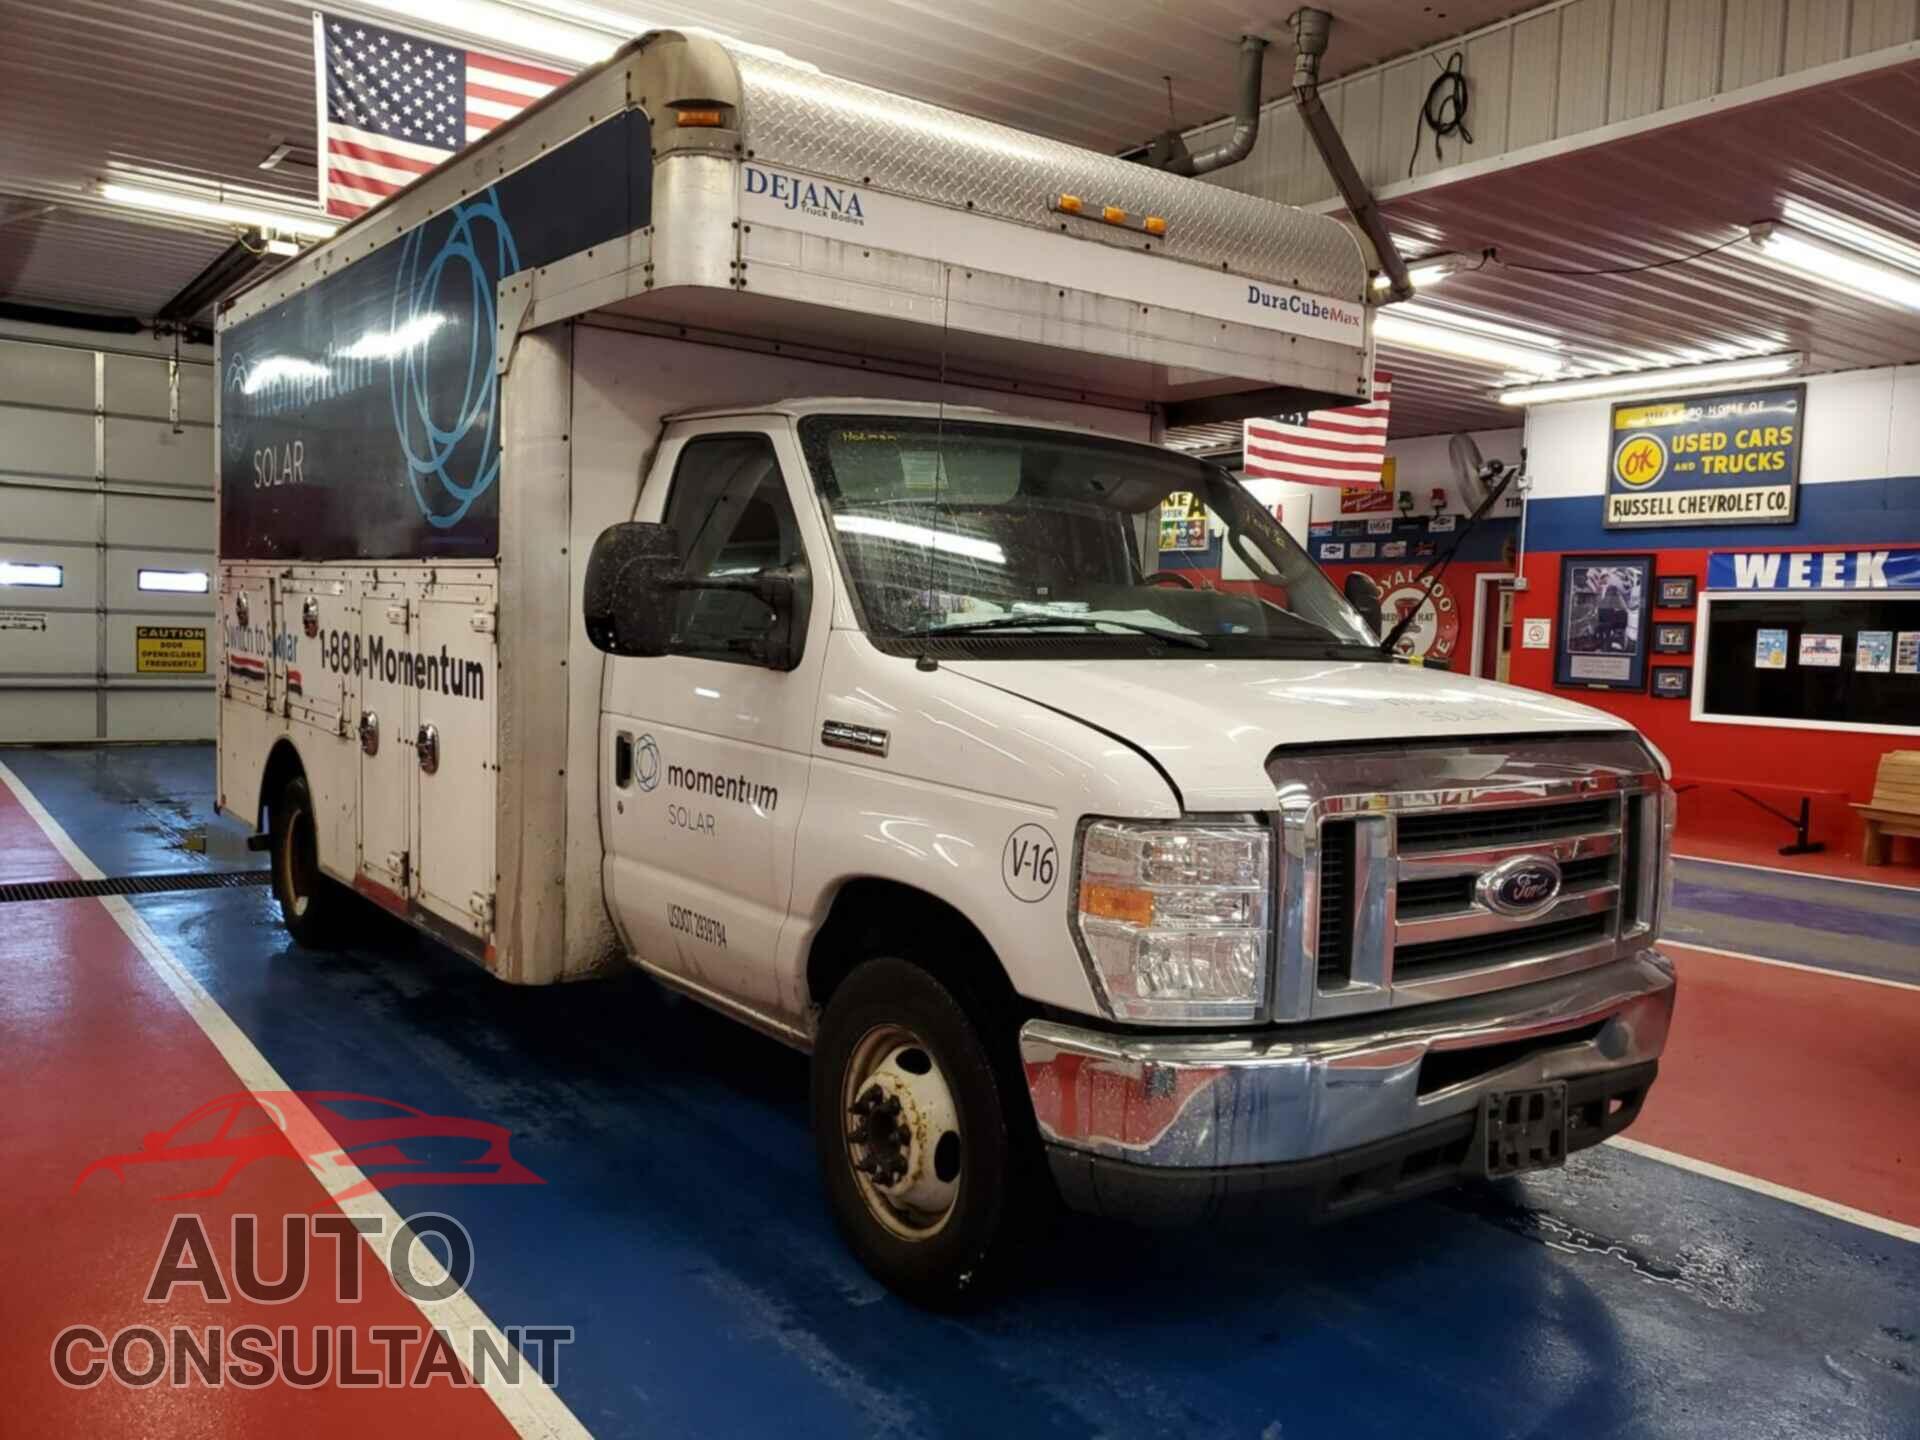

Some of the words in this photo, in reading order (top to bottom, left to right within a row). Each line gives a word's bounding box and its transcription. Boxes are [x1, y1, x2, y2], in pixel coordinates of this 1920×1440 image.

[745, 167, 864, 218] DEJANA
[801, 205, 829, 220] Truck
[831, 211, 865, 227] Bodies
[1672, 431, 1728, 454] USED
[1734, 426, 1793, 449] CARS
[254, 440, 304, 488] SOLAR
[1624, 446, 1655, 476] OK
[1674, 461, 1696, 471] AND
[1702, 451, 1786, 475] TRUCKS
[1613, 496, 1674, 517] RUSSELL
[1678, 492, 1764, 515] CHEVROLET
[1767, 491, 1788, 511] CO.
[1733, 551, 1890, 589] WEEK
[1420, 575, 1453, 612] 400
[138, 628, 205, 638] CAUTION
[319, 628, 485, 701] 1-888-Momentum
[668, 764, 778, 811] momentum
[668, 803, 716, 837] SOLAR
[1012, 837, 1054, 885] V-16
[1512, 872, 1549, 901] Ford
